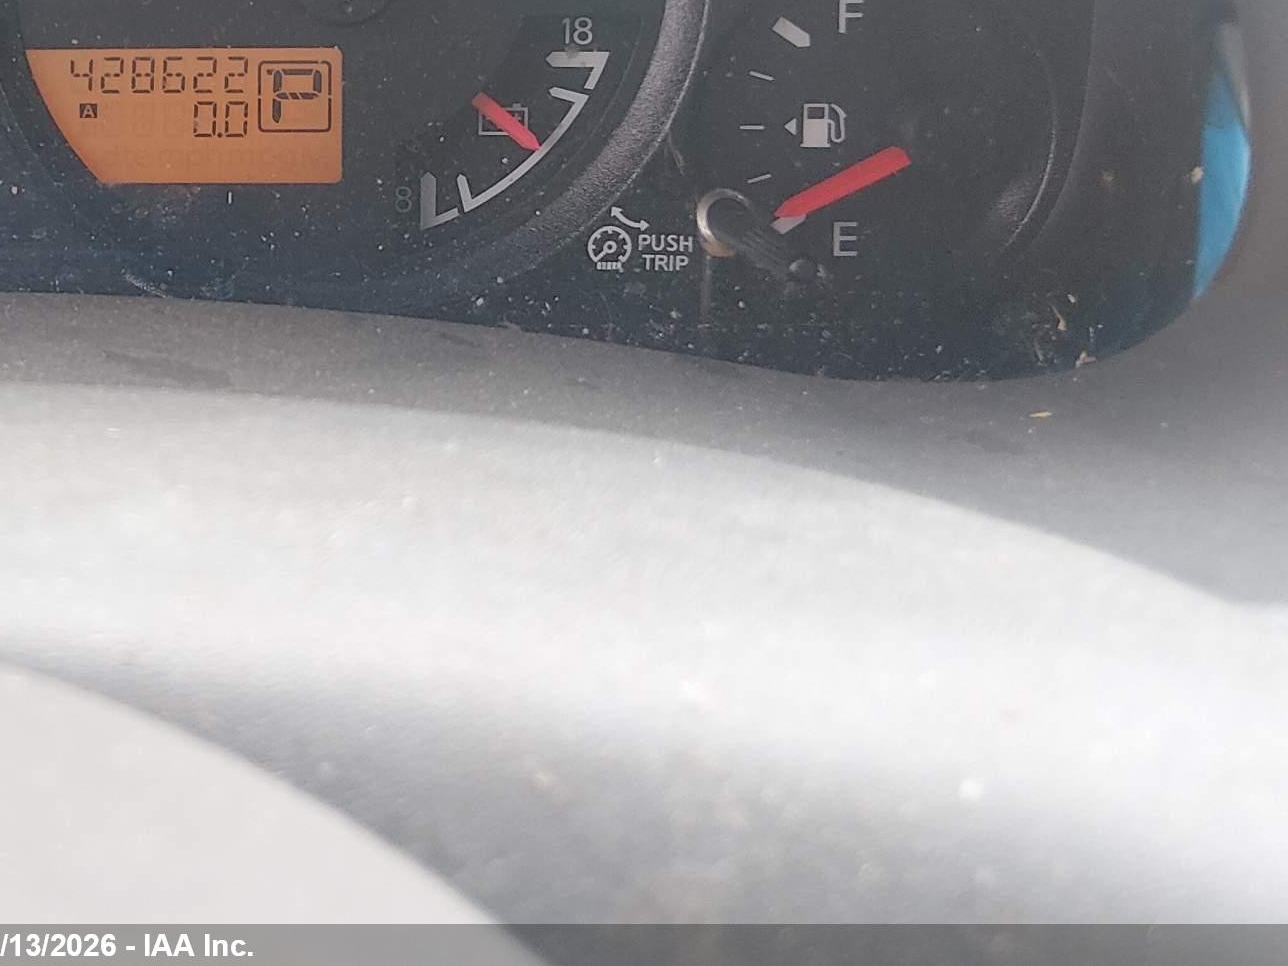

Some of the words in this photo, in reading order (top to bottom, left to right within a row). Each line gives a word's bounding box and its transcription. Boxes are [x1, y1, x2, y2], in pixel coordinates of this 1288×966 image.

[562, 17, 593, 45] 18
[70, 56, 249, 94] 428622
[266, 68, 323, 123] P
[81, 104, 96, 118] A
[193, 101, 249, 138] 0.0
[395, 186, 412, 213] 8
[638, 234, 693, 252] PUSH
[833, 221, 858, 257] E
[642, 254, 689, 272] TRIP
